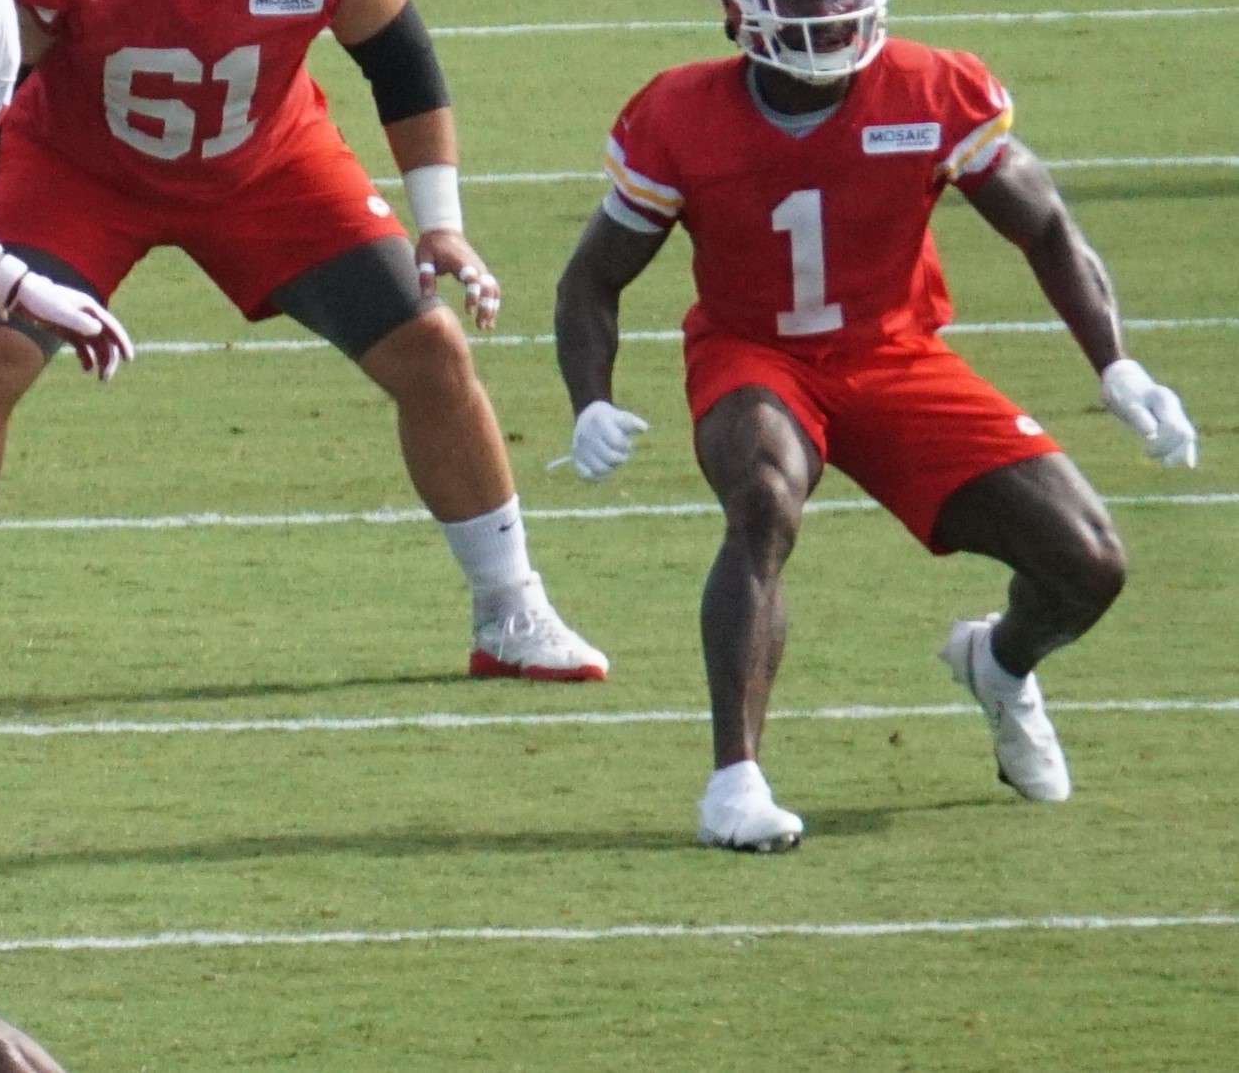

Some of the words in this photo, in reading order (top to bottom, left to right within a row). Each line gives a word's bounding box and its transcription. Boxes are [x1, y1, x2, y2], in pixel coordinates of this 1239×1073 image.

[103, 44, 261, 161] 61
[869, 128, 932, 143] MOSAIC
[771, 189, 844, 337] 1
